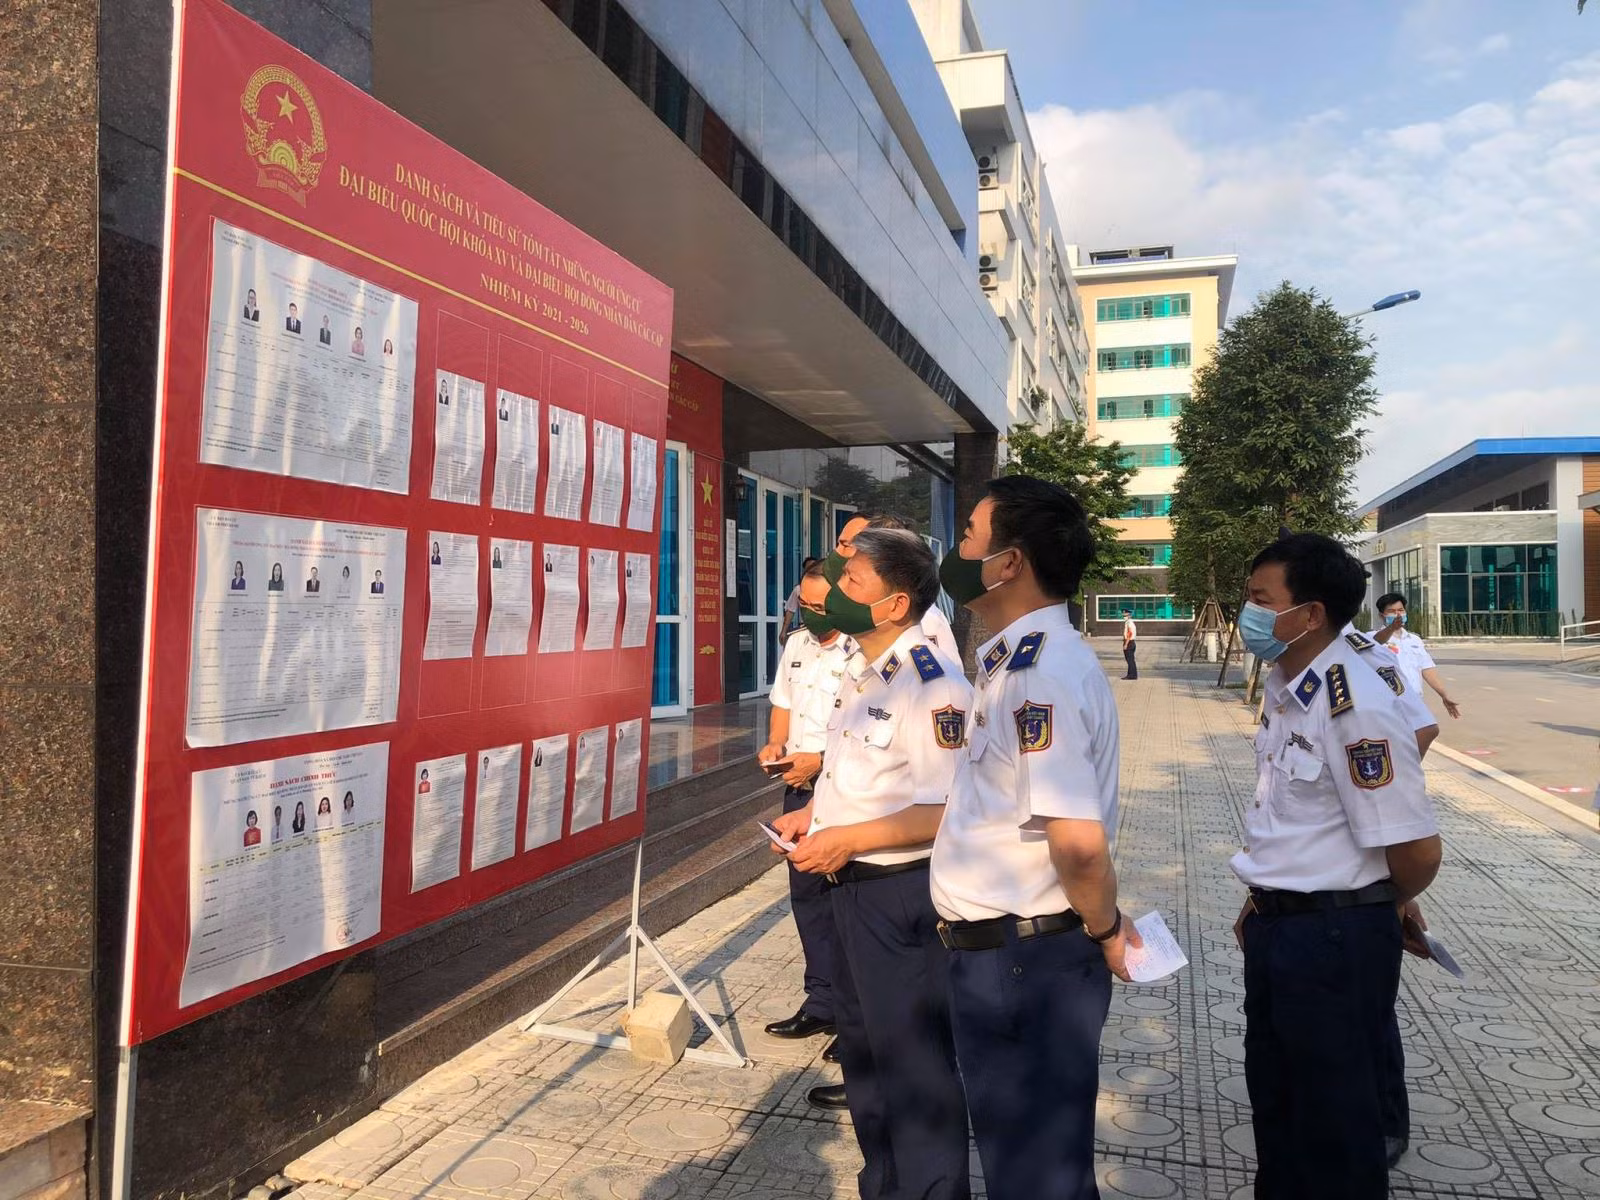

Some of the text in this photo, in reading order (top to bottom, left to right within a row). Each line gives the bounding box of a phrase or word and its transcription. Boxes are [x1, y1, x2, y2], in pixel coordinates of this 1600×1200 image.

[340, 165, 364, 197] ĐẠI
[402, 199, 437, 232] QUỐC
[440, 217, 461, 246] HỘI
[463, 229, 493, 261] KHÓA
[494, 246, 509, 267] XV
[511, 253, 523, 276] VÀ
[525, 262, 541, 287] ĐẠI
[564, 283, 579, 306] HỘI
[396, 163, 430, 198] DANH
[433, 183, 463, 216] SÁCH
[466, 201, 480, 226] VÀ
[522, 233, 542, 260] TÓM
[480, 273, 521, 303] NHIỆM
[543, 303, 562, 323] 2021
[570, 316, 589, 335] 2026
